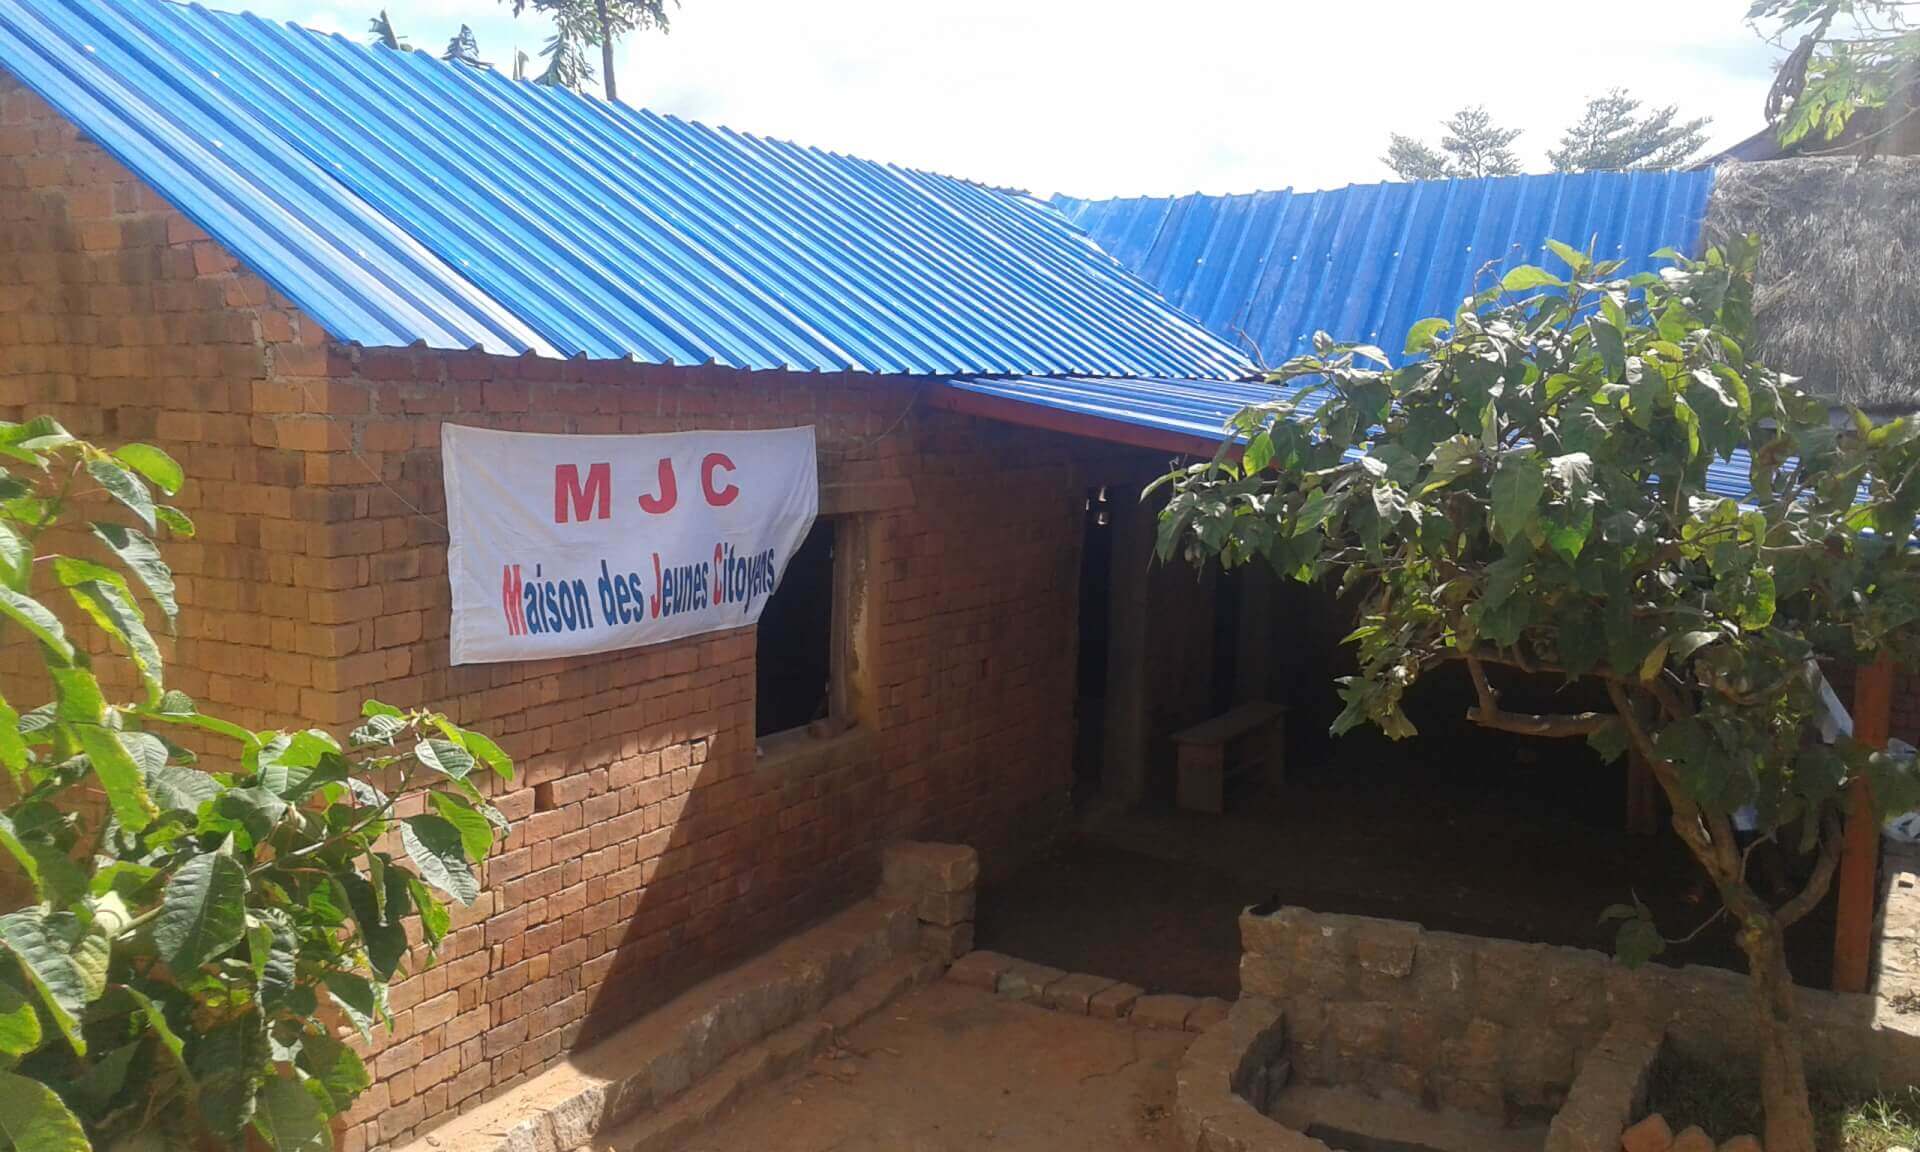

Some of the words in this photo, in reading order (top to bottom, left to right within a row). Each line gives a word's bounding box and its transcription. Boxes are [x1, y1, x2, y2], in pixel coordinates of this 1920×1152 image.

[502, 563, 593, 636] Maison
[599, 559, 644, 625] des
[649, 552, 709, 620] Jeunes
[713, 542, 775, 614] Citoyens
